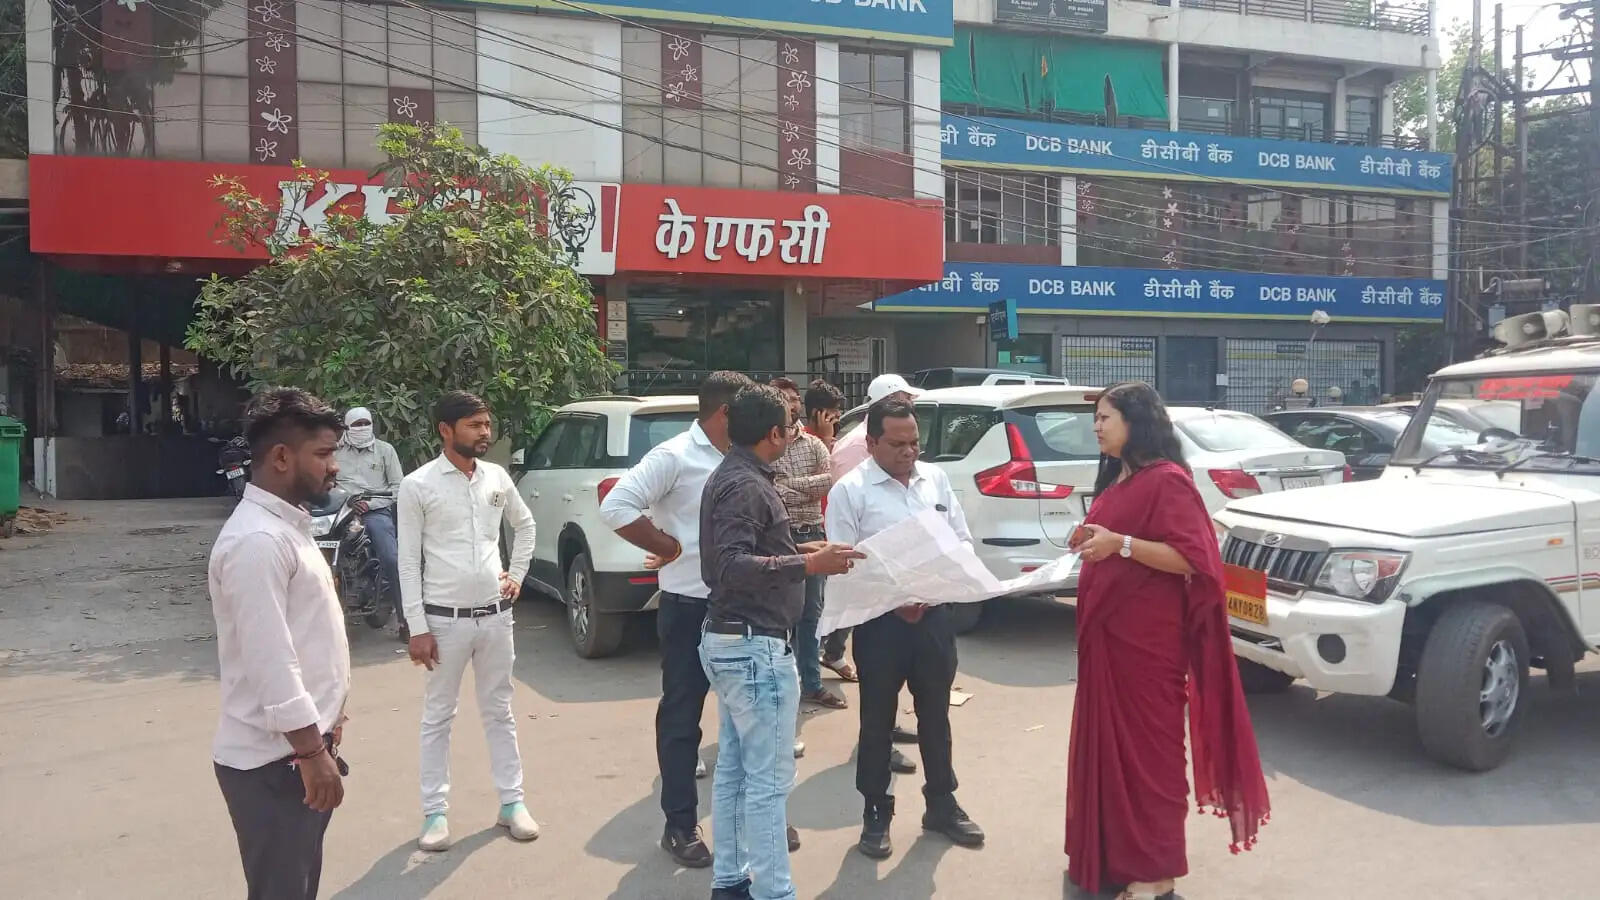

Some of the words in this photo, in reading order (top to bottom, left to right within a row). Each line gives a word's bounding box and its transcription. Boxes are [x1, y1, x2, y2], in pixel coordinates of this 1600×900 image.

[967, 126, 997, 147] बैंक
[1026, 135, 1061, 152] DCB
[1068, 138, 1113, 156] BANK
[1141, 139, 1200, 162] डीसीबी
[1207, 143, 1233, 163] बैंक
[1258, 151, 1290, 168] DCB
[1295, 154, 1336, 171] BANK
[1360, 155, 1411, 176] डीसीबी
[1418, 160, 1441, 179] बैंक
[970, 272, 1000, 293] बैंक
[1029, 278, 1064, 295] DCB
[1071, 280, 1116, 296] BANK
[1143, 277, 1202, 299] डीसीबी
[1209, 279, 1235, 300] बैंक
[1259, 286, 1291, 301] DCB
[1297, 287, 1337, 303] BANK
[1361, 285, 1413, 305] डीसीबी
[1420, 286, 1442, 306] बैंक
